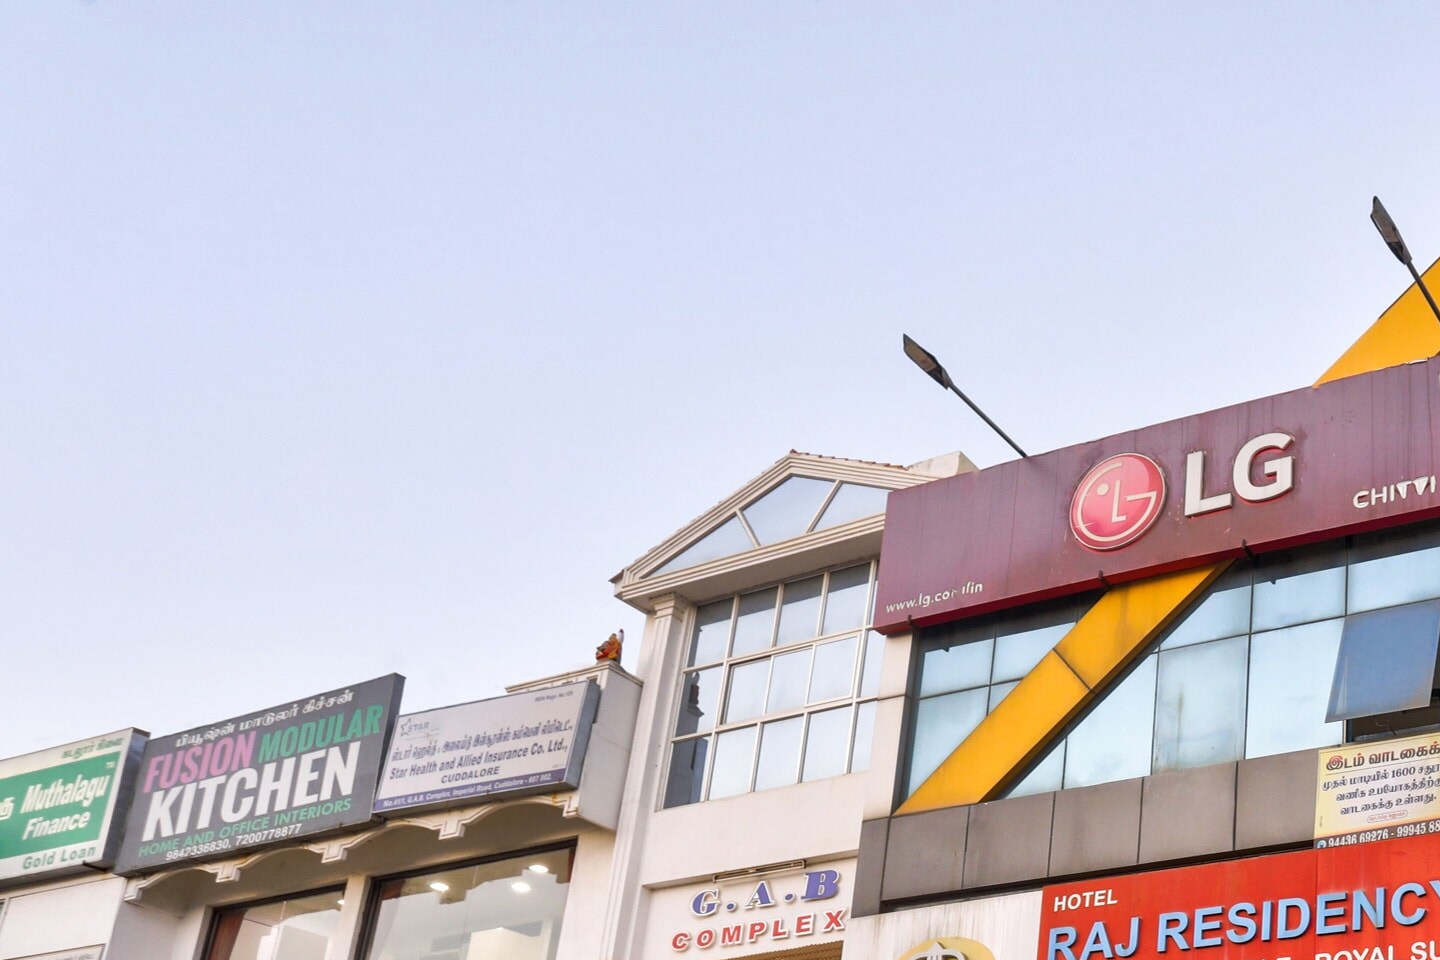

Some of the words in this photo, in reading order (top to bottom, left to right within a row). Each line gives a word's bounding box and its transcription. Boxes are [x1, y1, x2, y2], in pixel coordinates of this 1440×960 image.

[1183, 432, 1296, 518] LG
[143, 731, 256, 793] FUSION
[257, 705, 384, 763] MODULAR
[389, 767, 409, 780] Star
[409, 761, 438, 776] Health
[439, 757, 455, 772] and
[457, 752, 481, 768] Allied
[484, 746, 529, 764] Insurance
[1326, 753, 1364, 771] இடம்
[440, 766, 500, 784] CUDDALORE
[1391, 766, 1415, 779] 1600
[20, 774, 110, 815] Muthalagu
[141, 741, 361, 842] KITCHEN
[22, 811, 91, 840] Finance
[138, 839, 181, 858] HOME
[184, 832, 215, 846] AND
[219, 817, 269, 839] OFFICE
[274, 798, 352, 826] INTERIORS
[1397, 823, 1426, 837] 99945
[23, 851, 56, 870] Gold
[60, 847, 96, 862] Loan
[1054, 889, 1118, 912] HOTEL
[671, 908, 848, 952] COMPLEX
